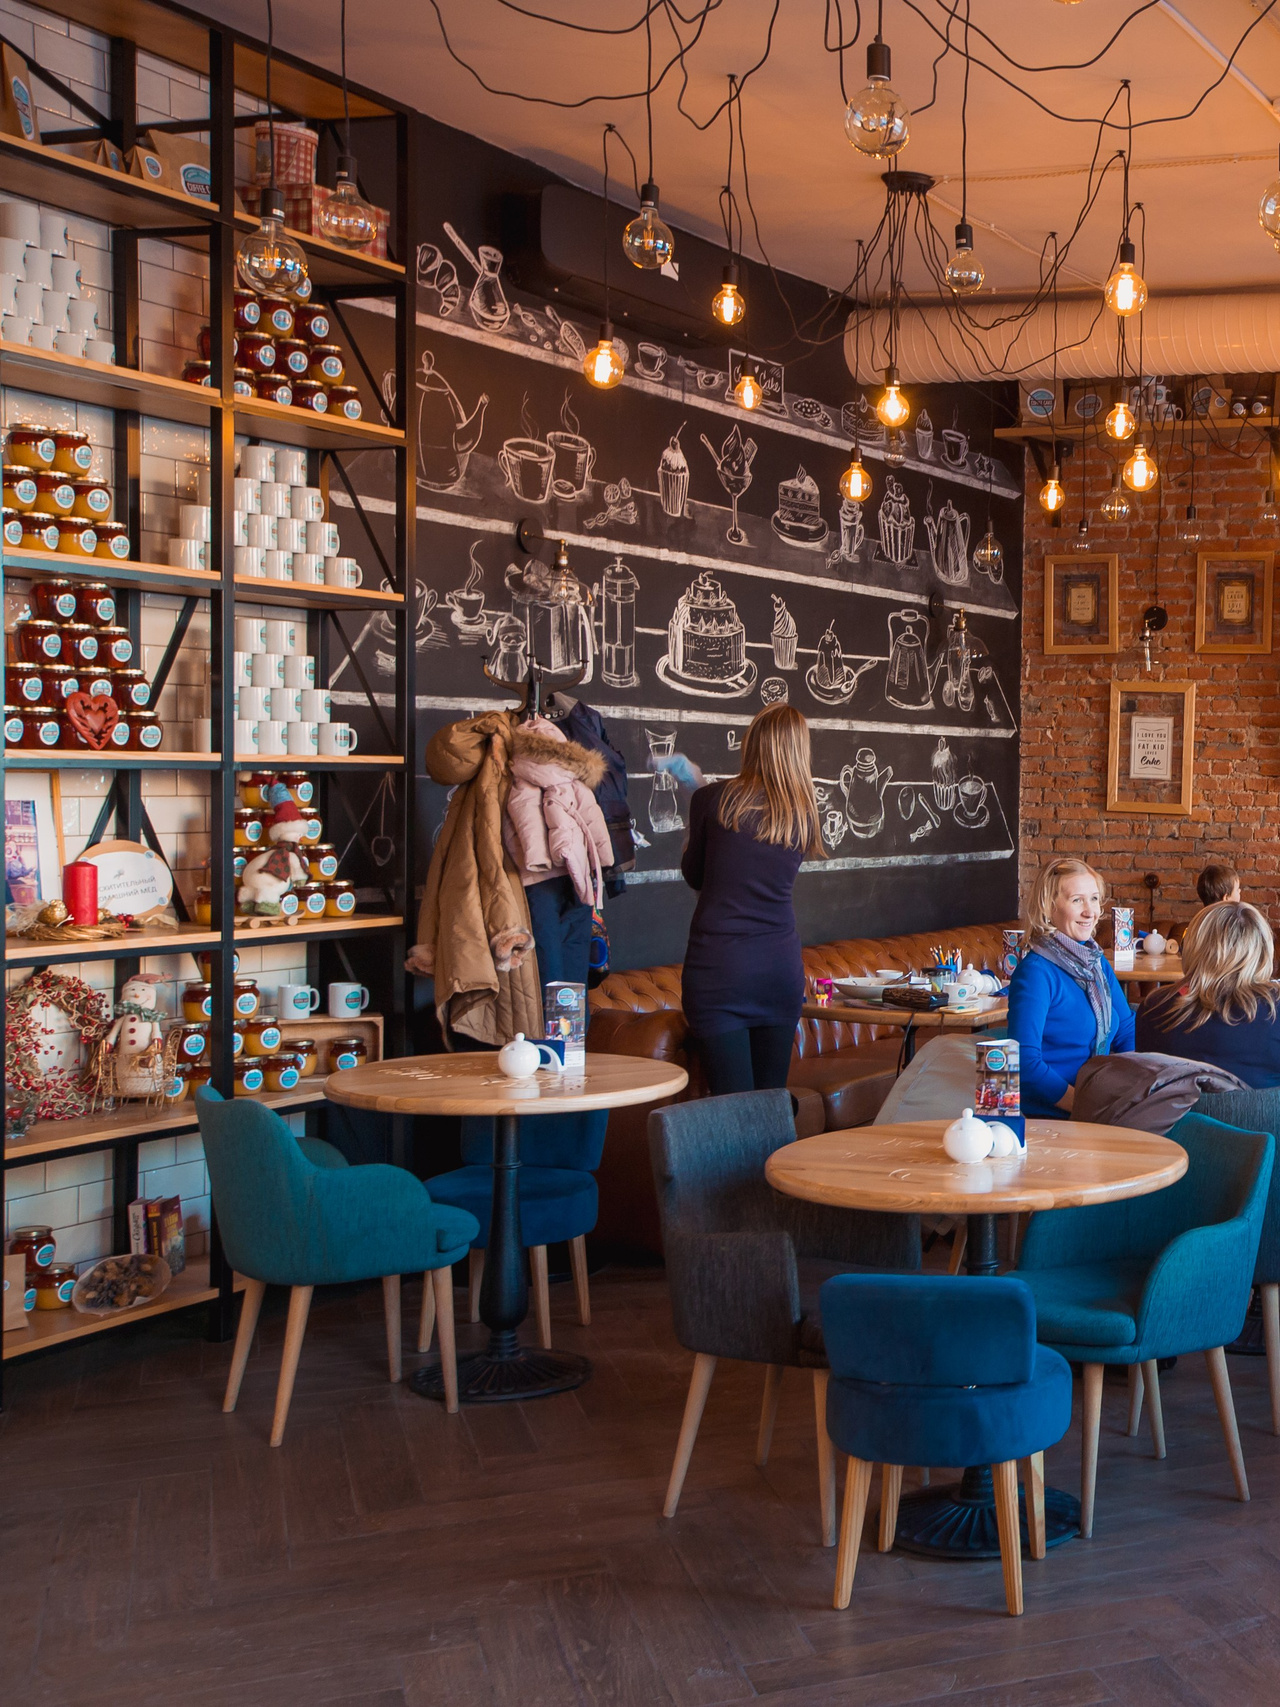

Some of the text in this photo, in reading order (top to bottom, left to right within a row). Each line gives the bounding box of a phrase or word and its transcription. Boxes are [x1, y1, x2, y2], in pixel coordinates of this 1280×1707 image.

[1140, 755, 1161, 766] Cake
[99, 875, 157, 892] СХИТИТЕЛЬНЫЙ
[99, 888, 139, 902] ОМАШНИЙ
